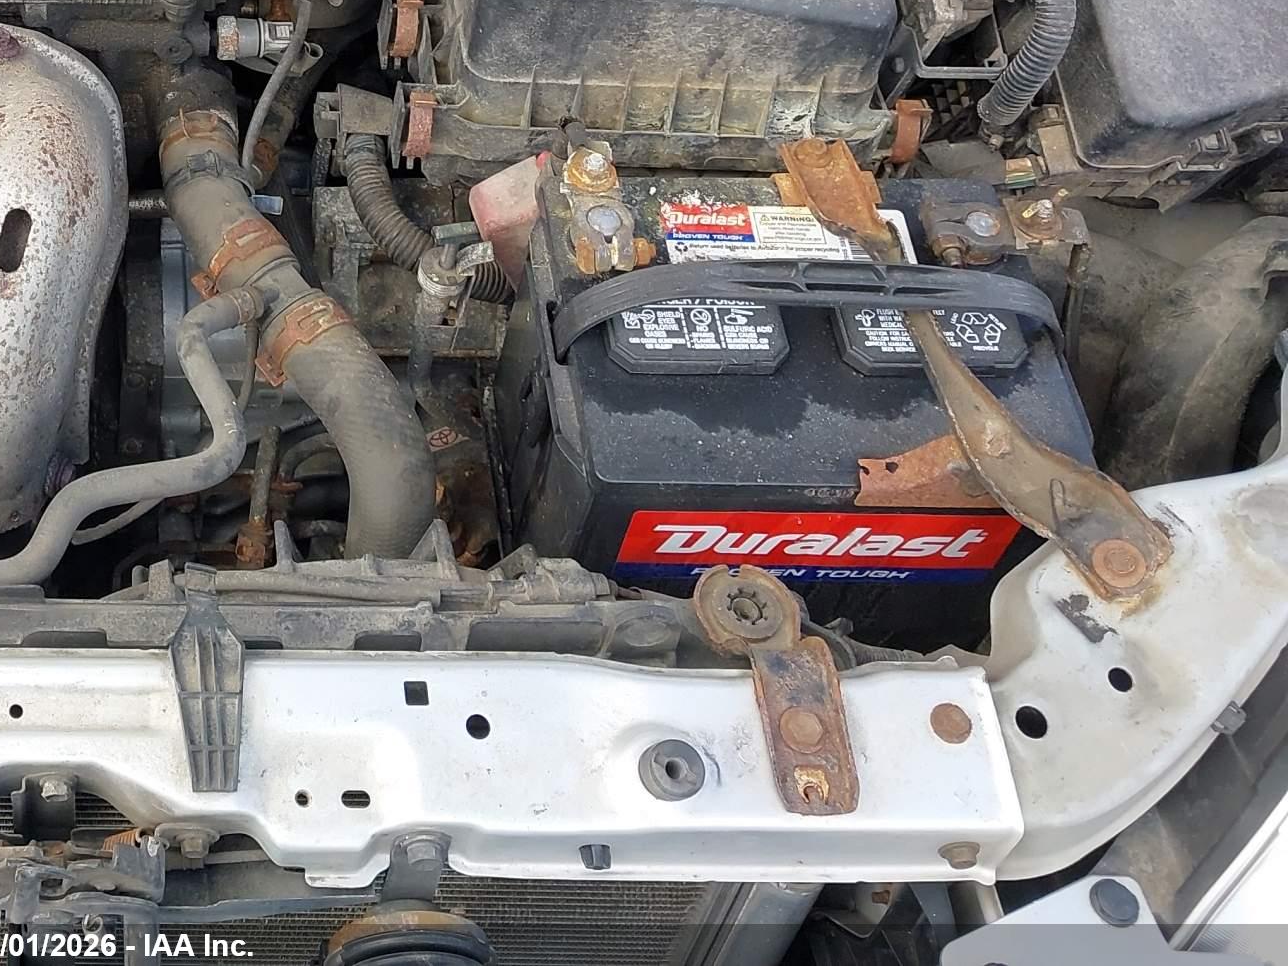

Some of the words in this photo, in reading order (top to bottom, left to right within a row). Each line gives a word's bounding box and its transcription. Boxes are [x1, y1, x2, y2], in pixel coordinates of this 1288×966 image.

[668, 211, 746, 227] Duralast
[723, 325, 756, 333] SULFURIC
[756, 325, 773, 334] ACID
[653, 524, 989, 559] Duralast
[815, 569, 912, 580] TOUGH
